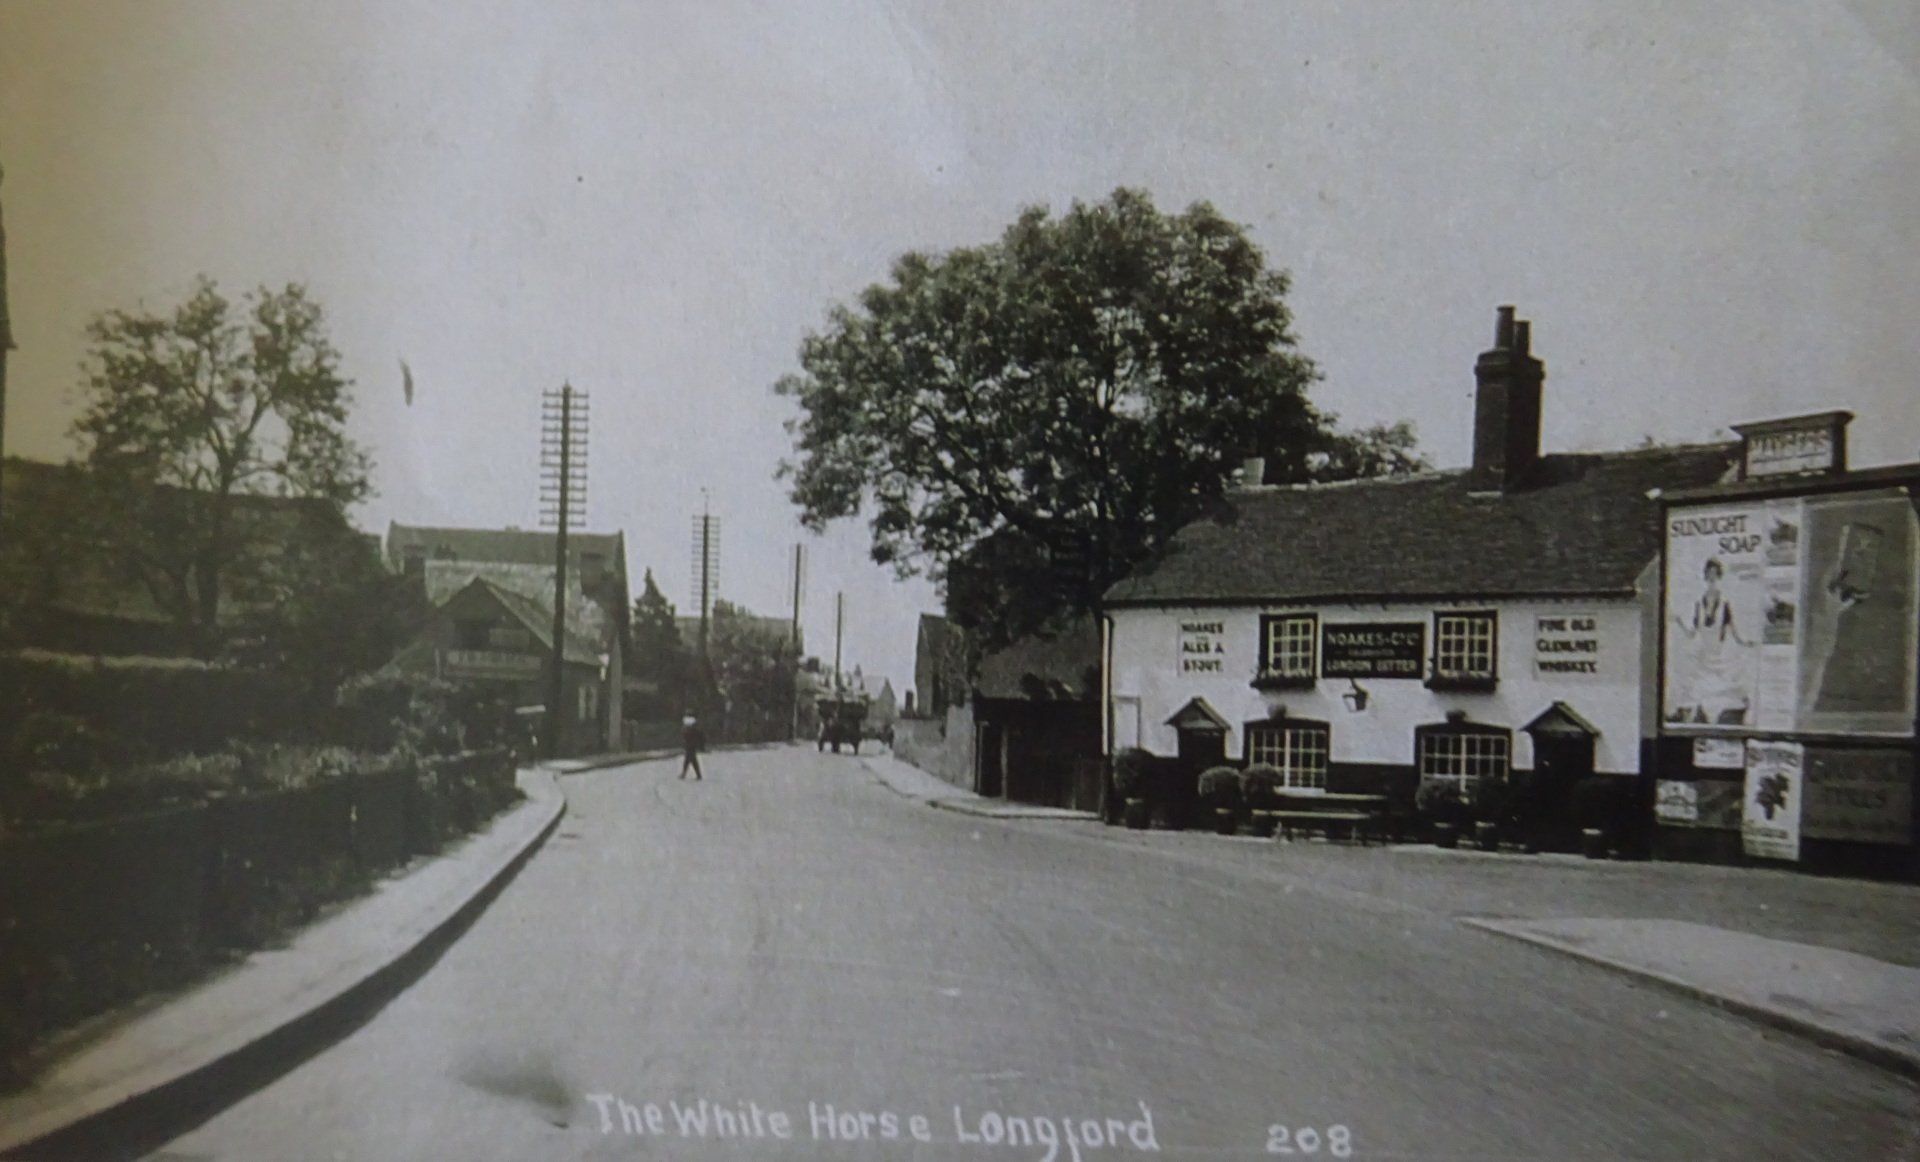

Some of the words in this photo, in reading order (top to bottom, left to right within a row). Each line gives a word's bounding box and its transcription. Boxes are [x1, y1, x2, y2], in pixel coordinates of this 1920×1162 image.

[1672, 515, 1748, 537] SUNLIGHT
[1719, 534, 1761, 554] SOAP
[1327, 632, 1386, 647] NOAKES
